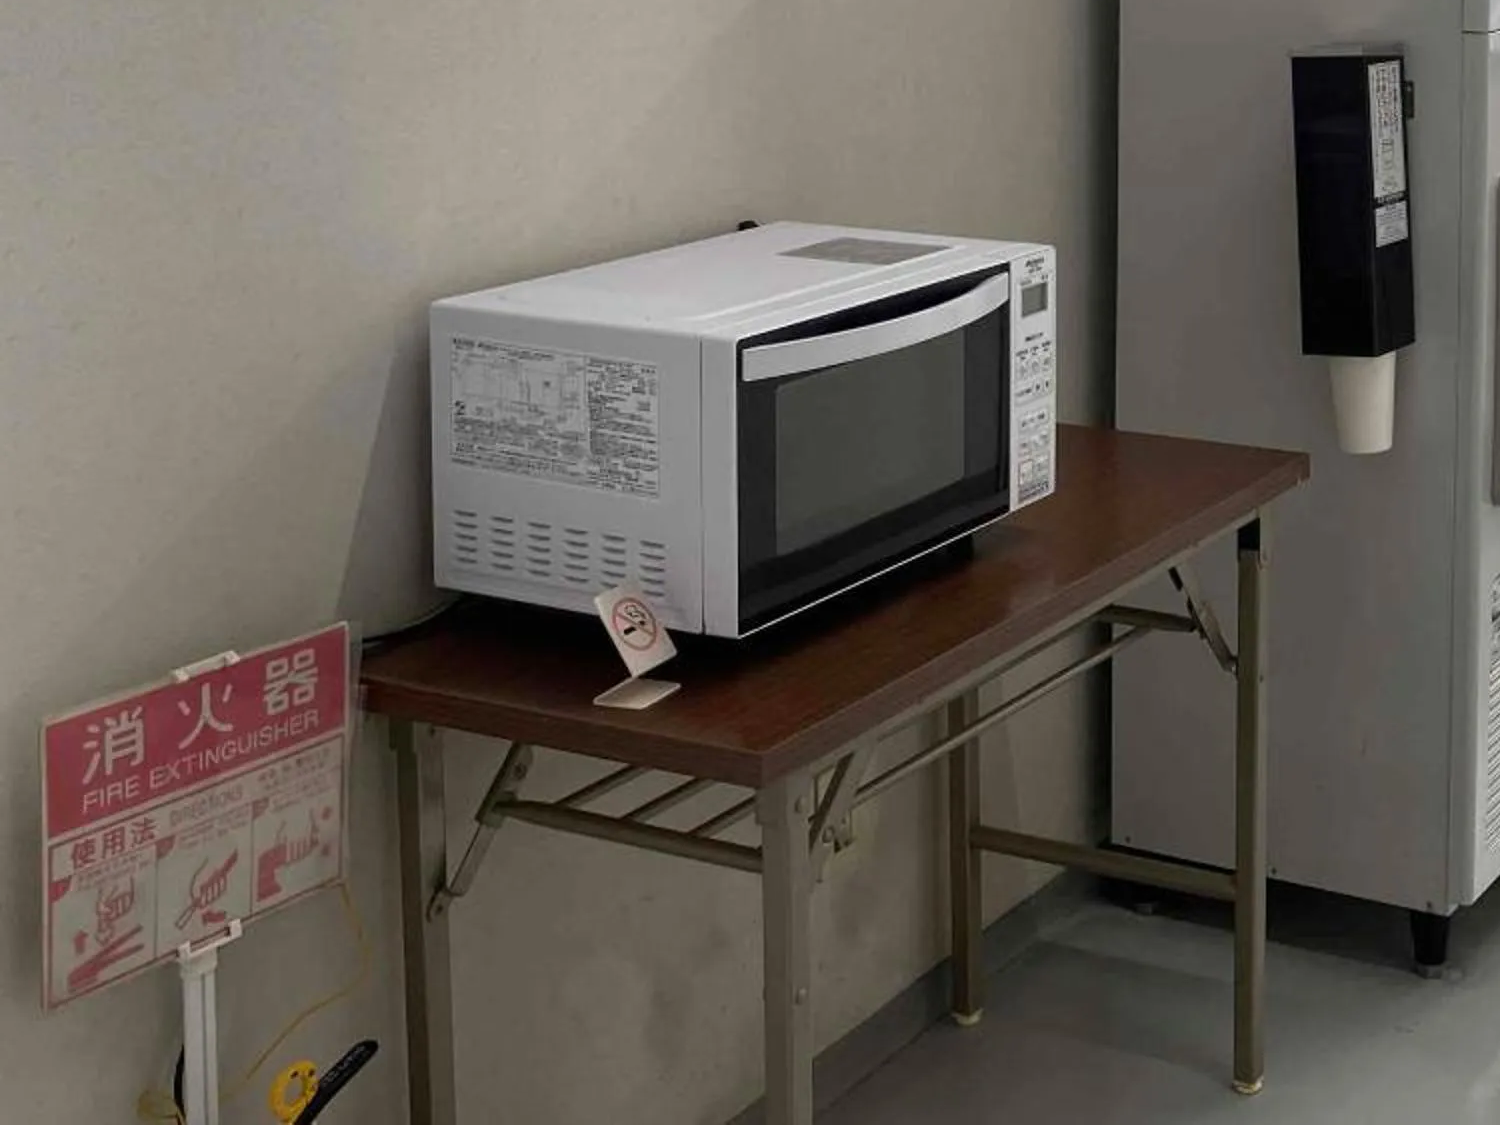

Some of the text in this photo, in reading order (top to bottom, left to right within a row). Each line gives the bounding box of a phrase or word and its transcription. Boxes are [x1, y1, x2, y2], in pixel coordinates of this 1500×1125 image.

[82, 648, 319, 785] 消火器
[82, 777, 140, 814] FIRE
[149, 709, 319, 791] EXTINGUISHER
[70, 817, 157, 869] 使用法
